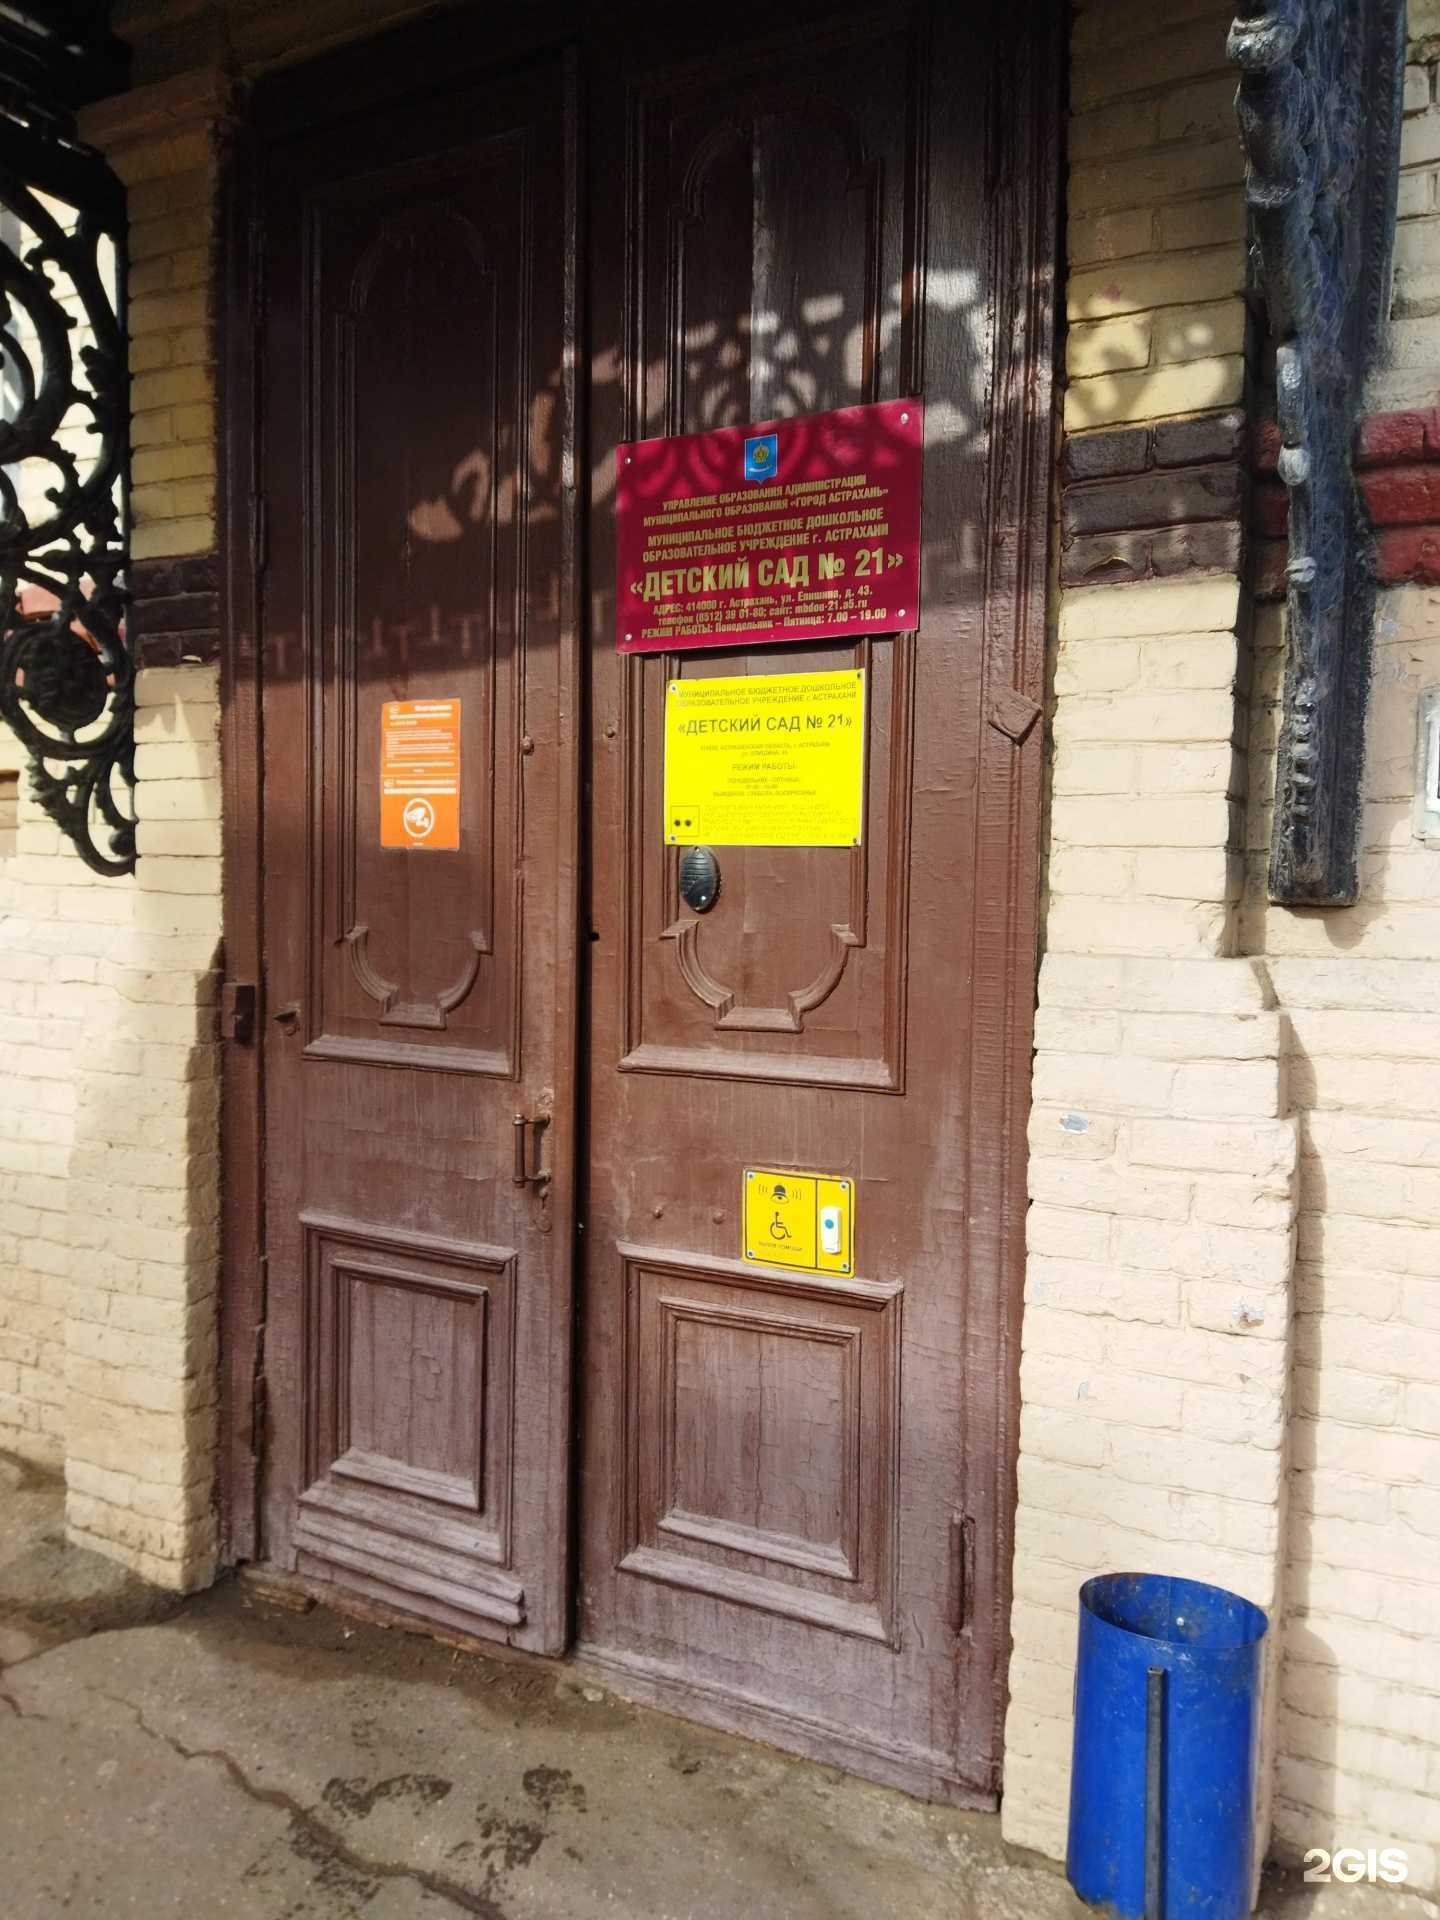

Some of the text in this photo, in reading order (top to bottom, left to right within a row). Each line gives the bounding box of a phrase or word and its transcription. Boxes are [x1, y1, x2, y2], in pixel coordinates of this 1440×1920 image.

[663, 474, 867, 511] УПРАВЛЕНИЕ ОБРАЗОВАНИЯ АДМИНИСТРАЦИИ
[643, 507, 722, 528] МУНИЦИПАЛЬНОГО
[724, 498, 788, 516] ОБРАЗОВАНИЯ
[647, 507, 884, 548] МУНИЦИПАЛЬНОЕ БЮДЖЕТНОЕ ДОШКОЛЬНОЕ
[643, 541, 737, 564] ОБРАЗОВАТЕЛЬНОЕ
[740, 532, 810, 551] УЧРЕЖДЕНИЕ
[825, 523, 889, 543] АСТРАХАНИ
[630, 547, 904, 602] «ДЕТСКИЙ САД № 21»
[642, 627, 673, 639] РЕЖИМ
[675, 623, 713, 637] РАБОТЫ:
[860, 608, 887, 621] 19.00
[678, 712, 852, 736] «ДЕТСКИЙ САД № 21»
